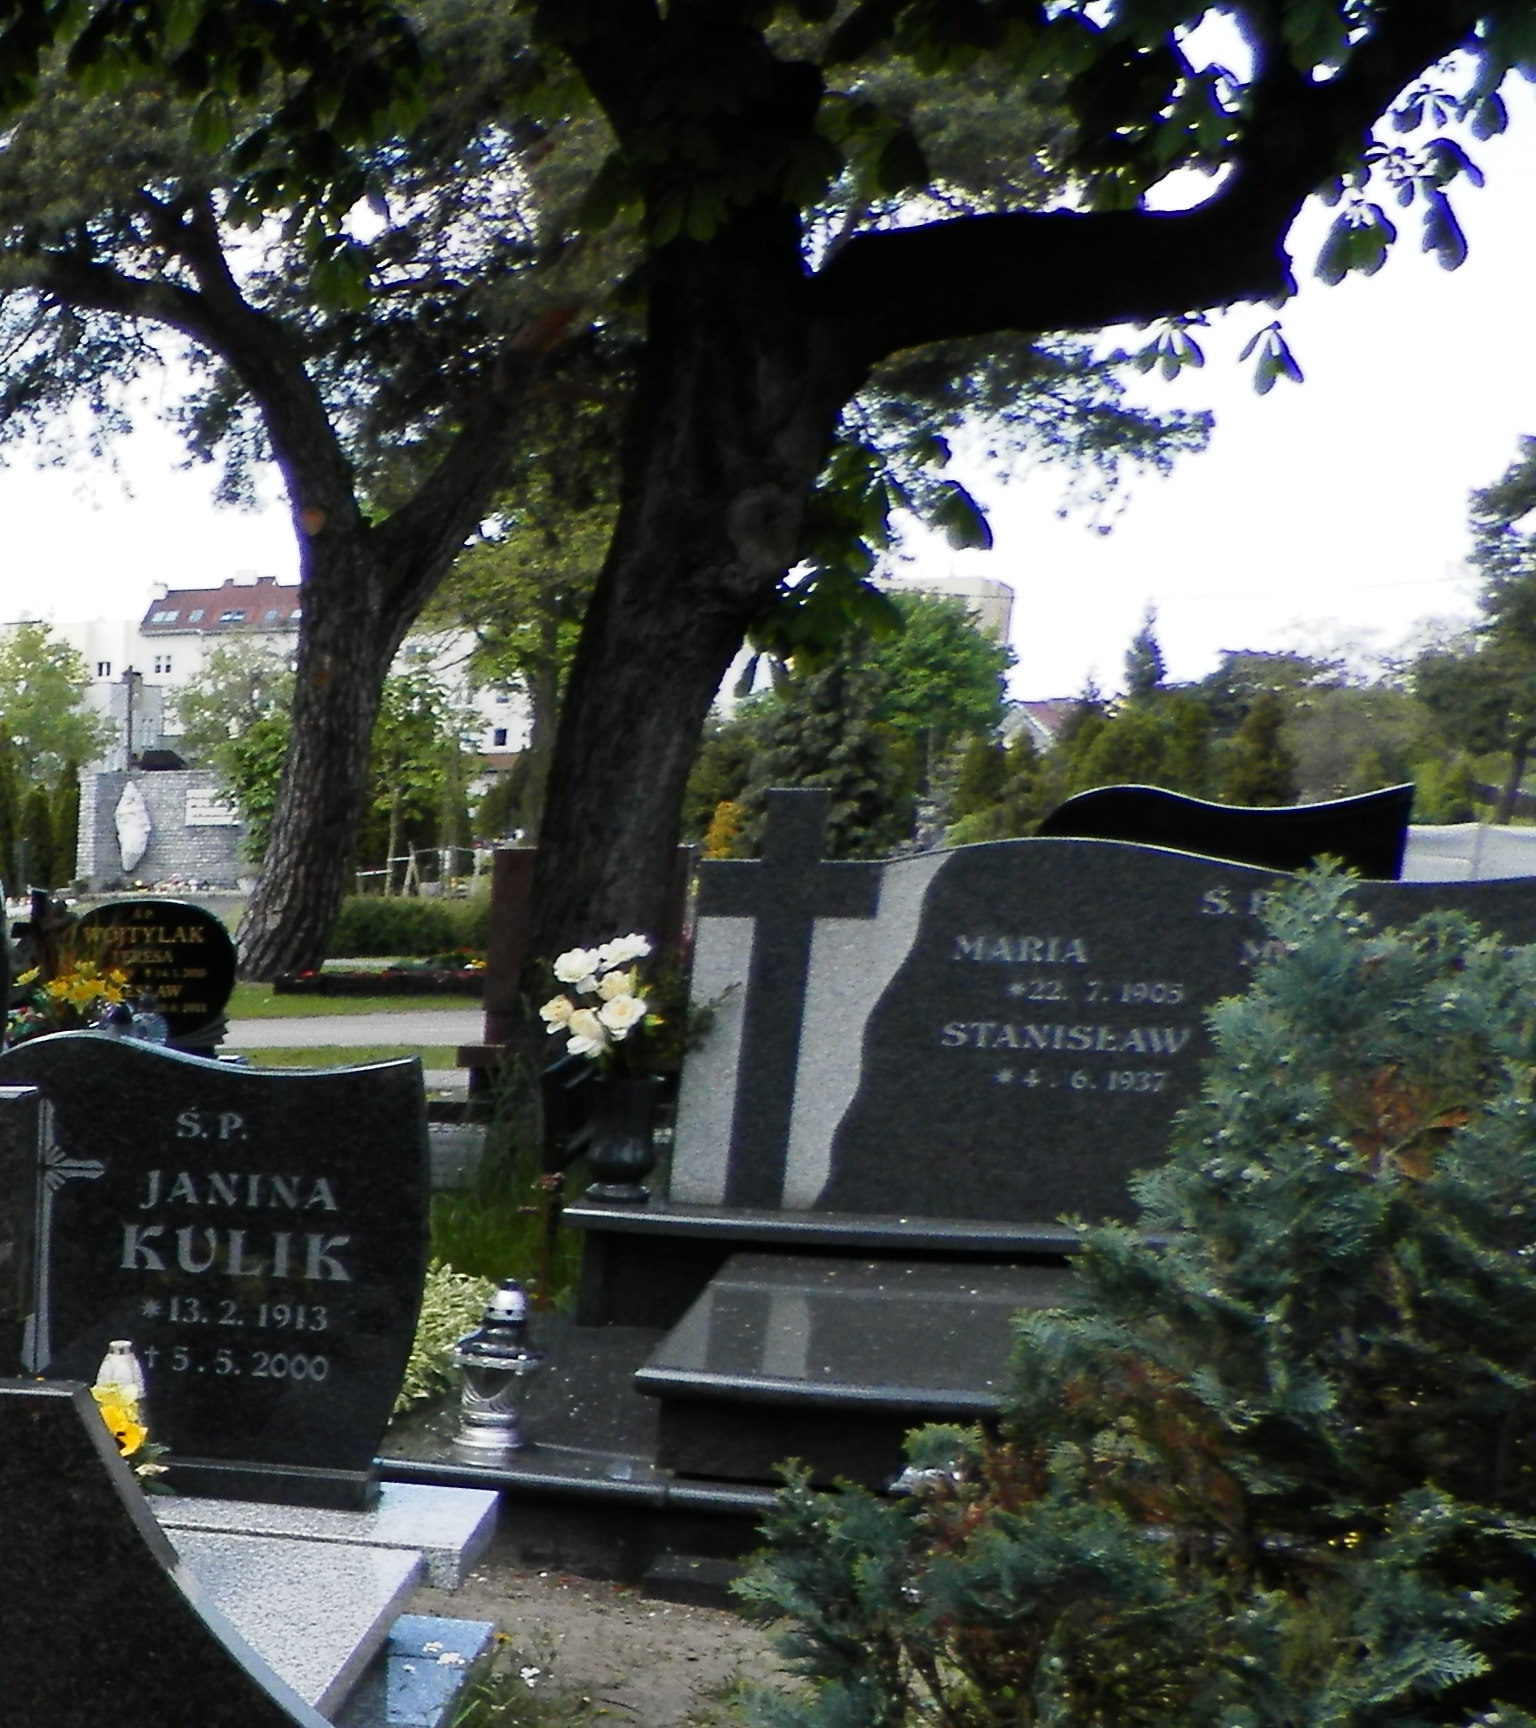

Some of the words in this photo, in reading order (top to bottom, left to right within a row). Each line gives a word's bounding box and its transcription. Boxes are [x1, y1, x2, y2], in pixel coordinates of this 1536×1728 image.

[953, 935, 1089, 963] MARIA
[140, 1167, 337, 1212] JANINA
[120, 1223, 351, 1282] KULIK
